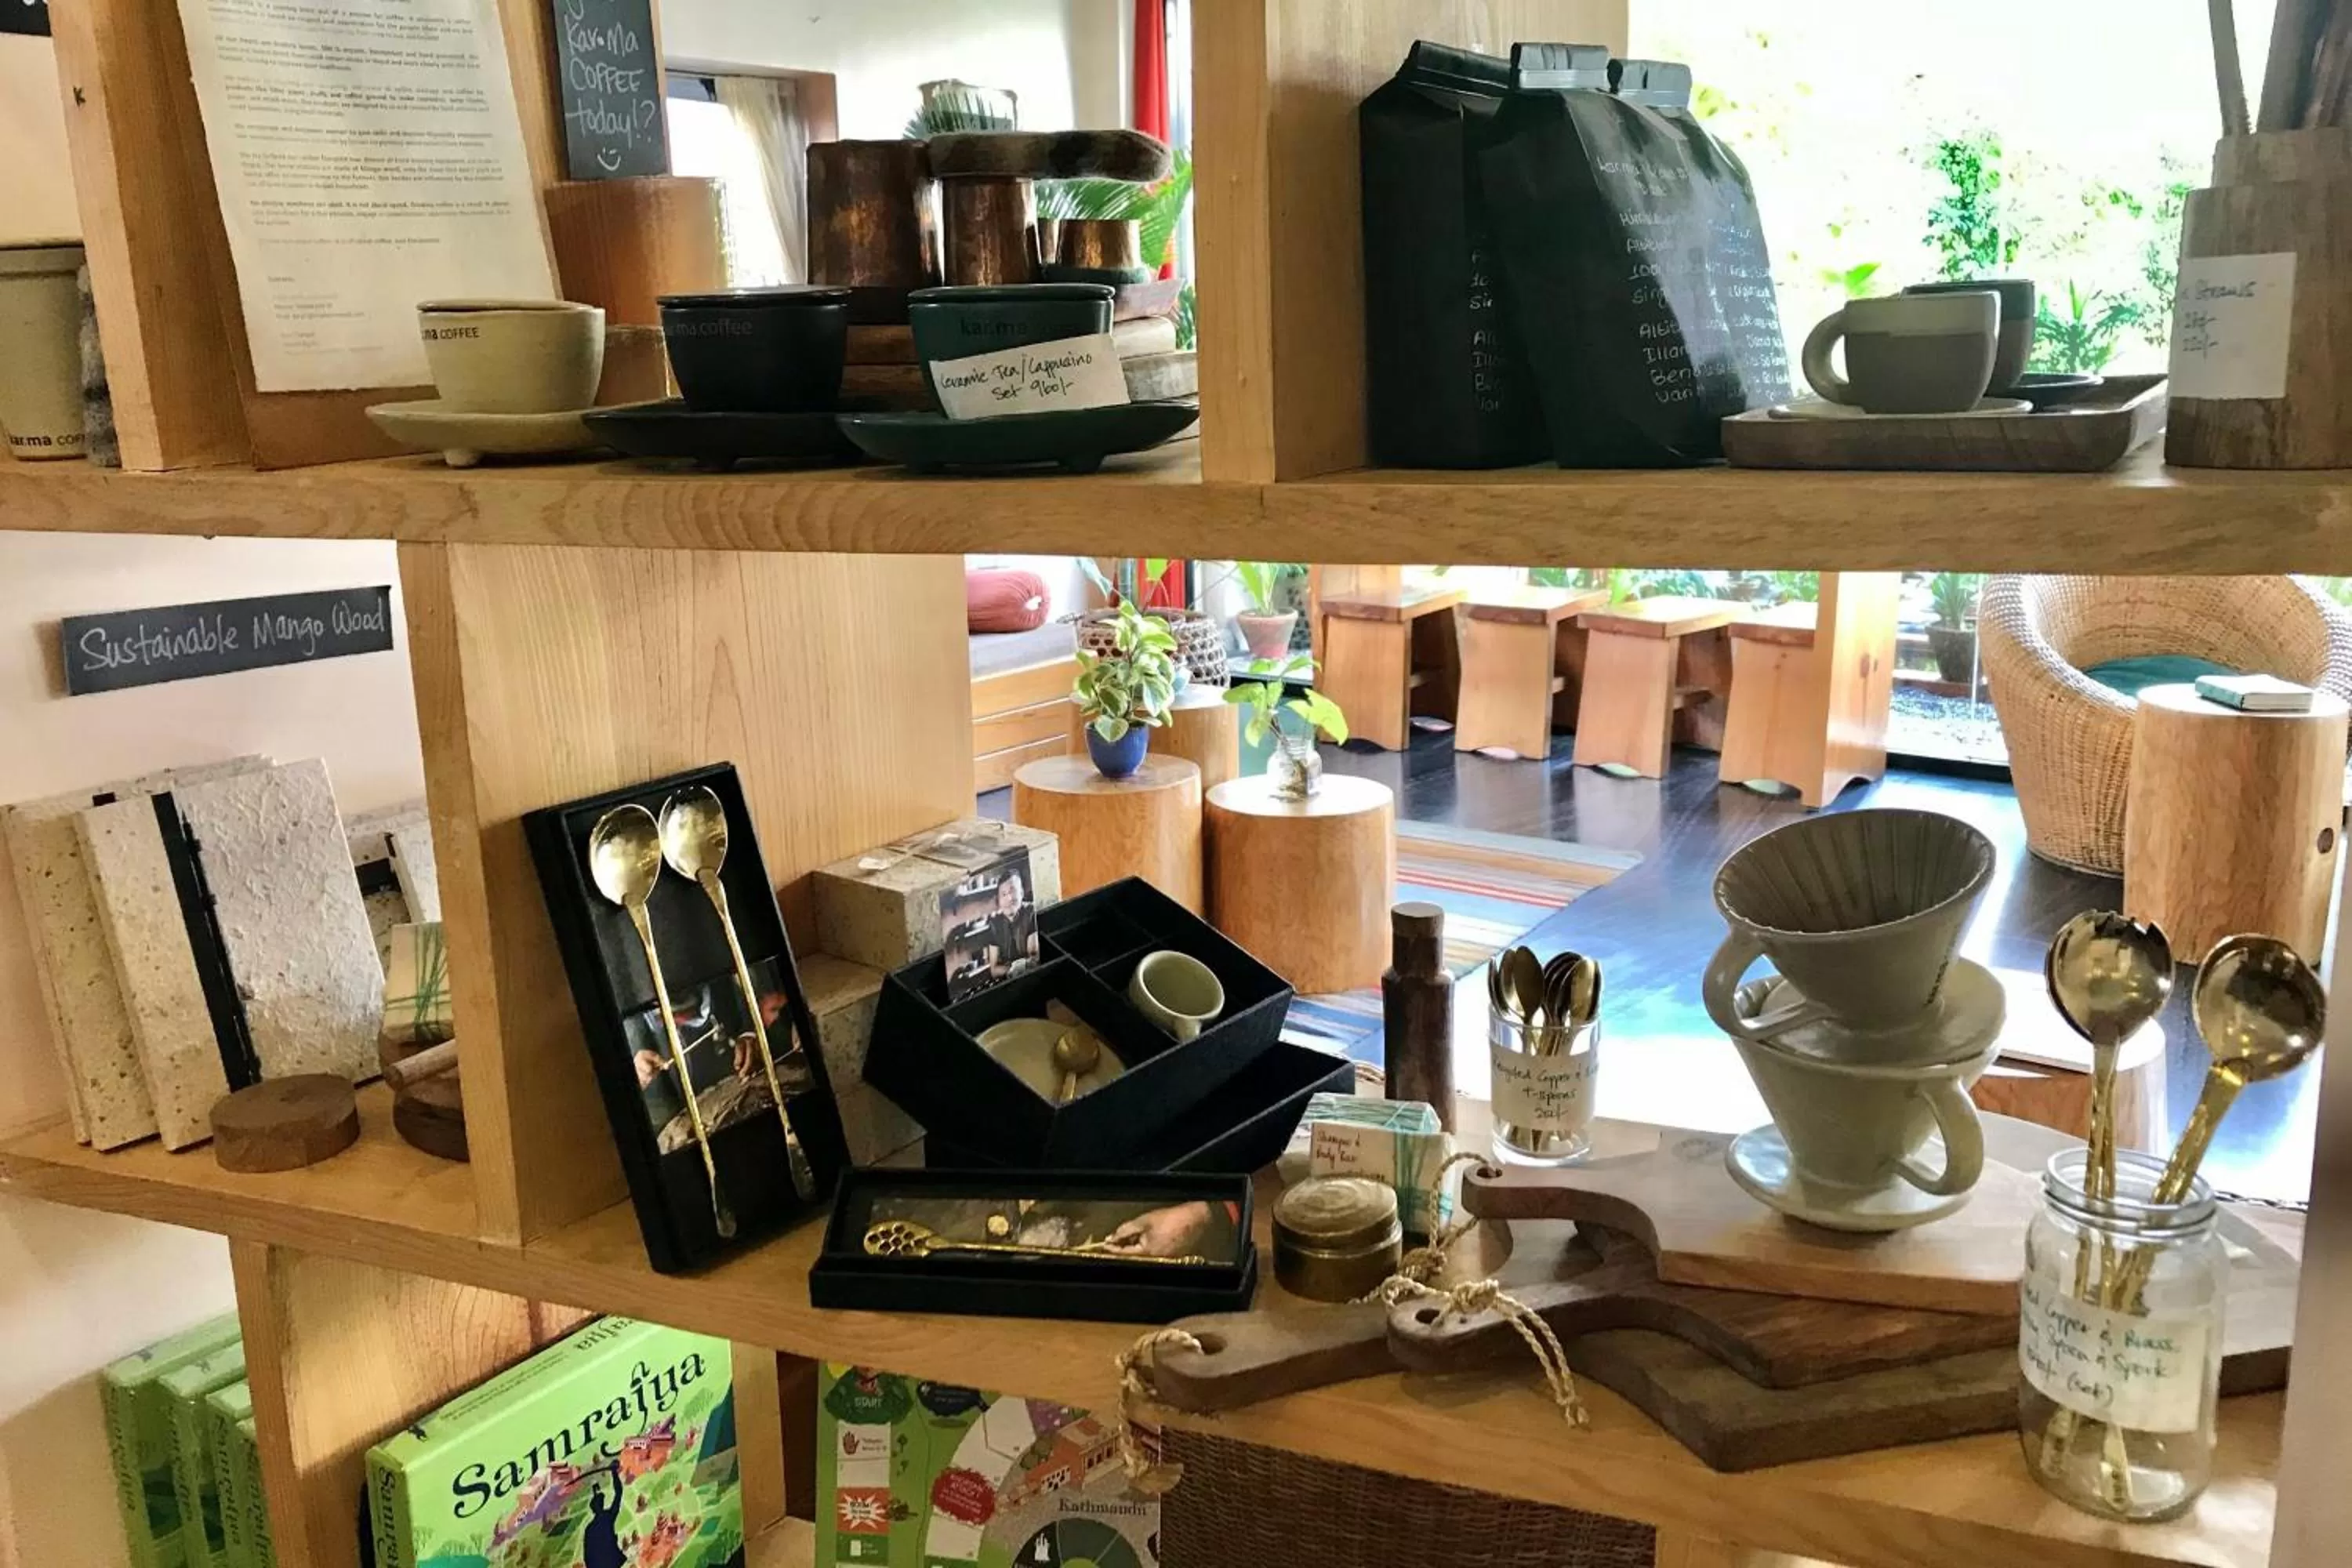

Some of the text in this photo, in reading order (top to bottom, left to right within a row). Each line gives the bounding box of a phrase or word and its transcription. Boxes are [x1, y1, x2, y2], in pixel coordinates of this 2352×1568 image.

[569, 56, 646, 94] COFFEE
[441, 326, 480, 339] COFFEE
[79, 596, 385, 671] Sustainable Mango Wood
[452, 1352, 707, 1519] Samrajya
[1058, 1498, 1148, 1517] Kathmandu
